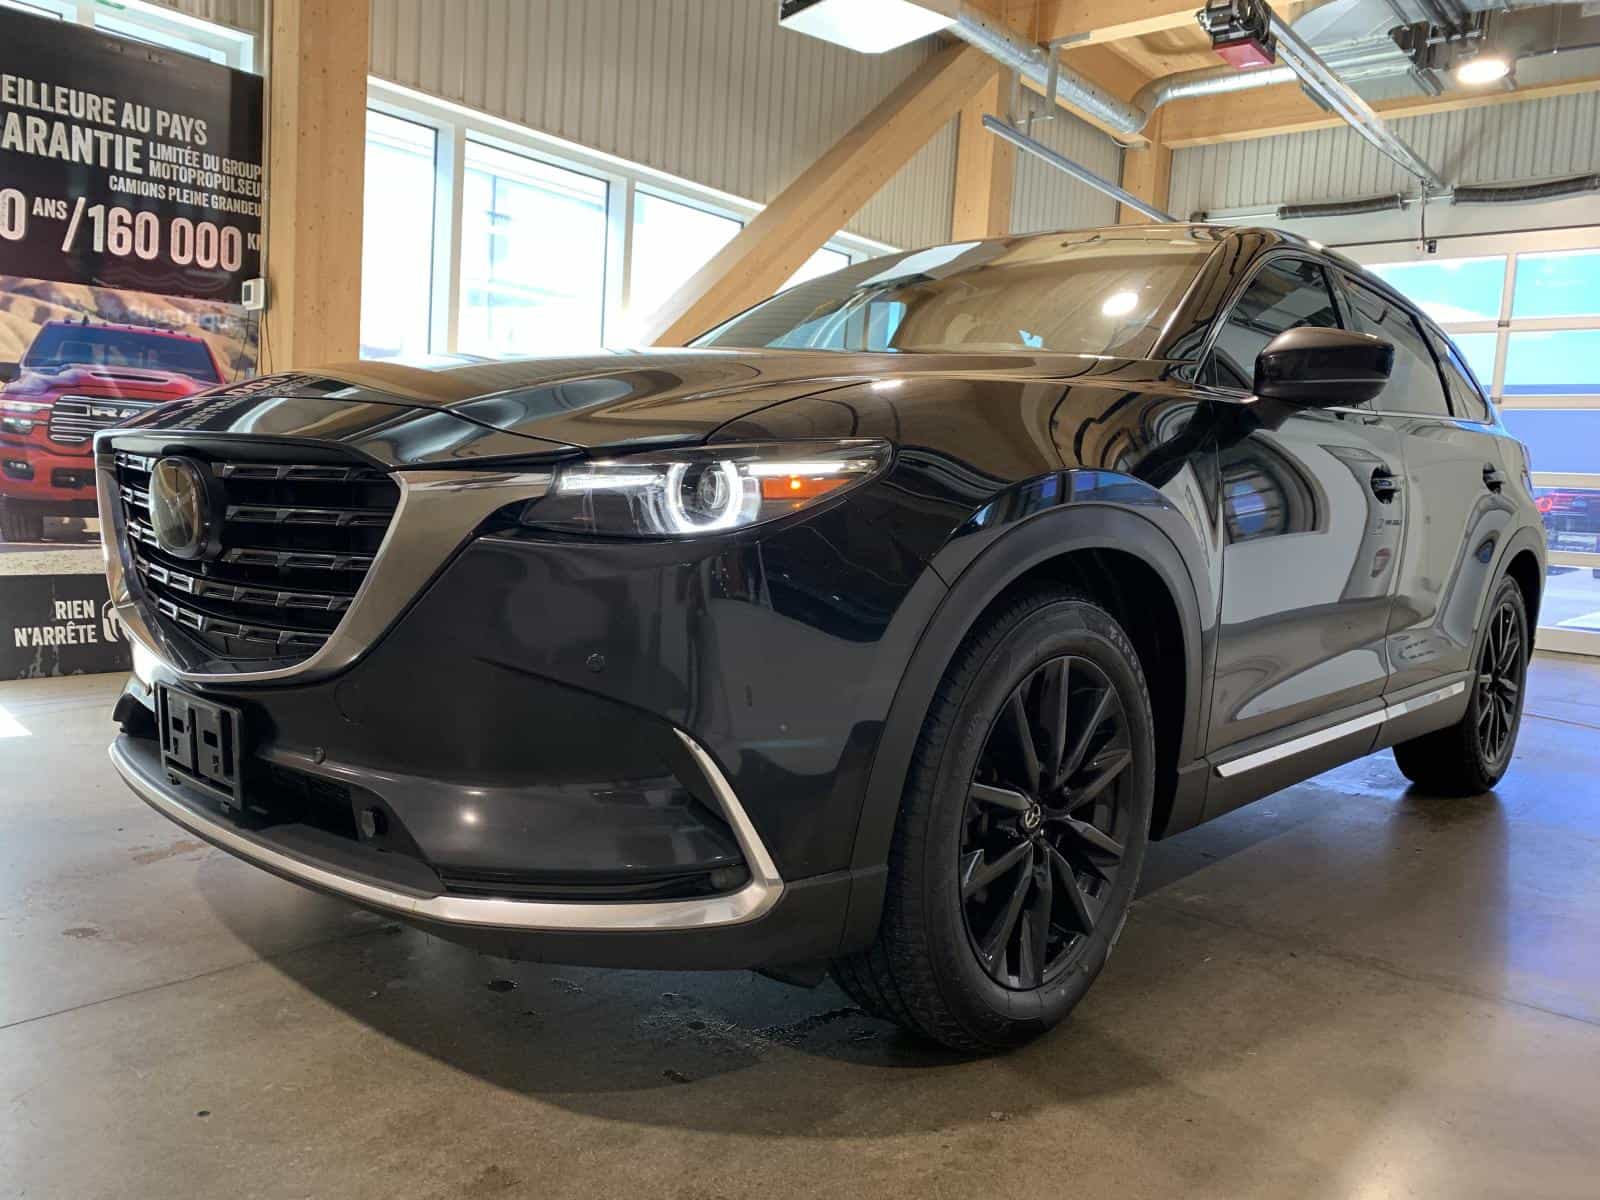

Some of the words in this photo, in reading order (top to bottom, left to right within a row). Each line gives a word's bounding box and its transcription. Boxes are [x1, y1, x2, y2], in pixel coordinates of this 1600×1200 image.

[1, 74, 116, 126] EILLEURE
[121, 102, 150, 133] AU
[156, 109, 207, 146] PAYS
[0, 111, 143, 174] ARANTIE
[149, 141, 200, 168] LIMITÉE
[203, 153, 220, 172] DU
[109, 175, 166, 200] CAMIONS
[168, 186, 209, 208] PLEINE
[149, 160, 261, 198] MOTOPROPULSEU
[32, 196, 68, 220] ANS
[170, 217, 242, 272] 000
[91, 407, 140, 418] RA
[55, 600, 96, 620] RIEN
[14, 620, 98, 648] N'ARRÊTE
